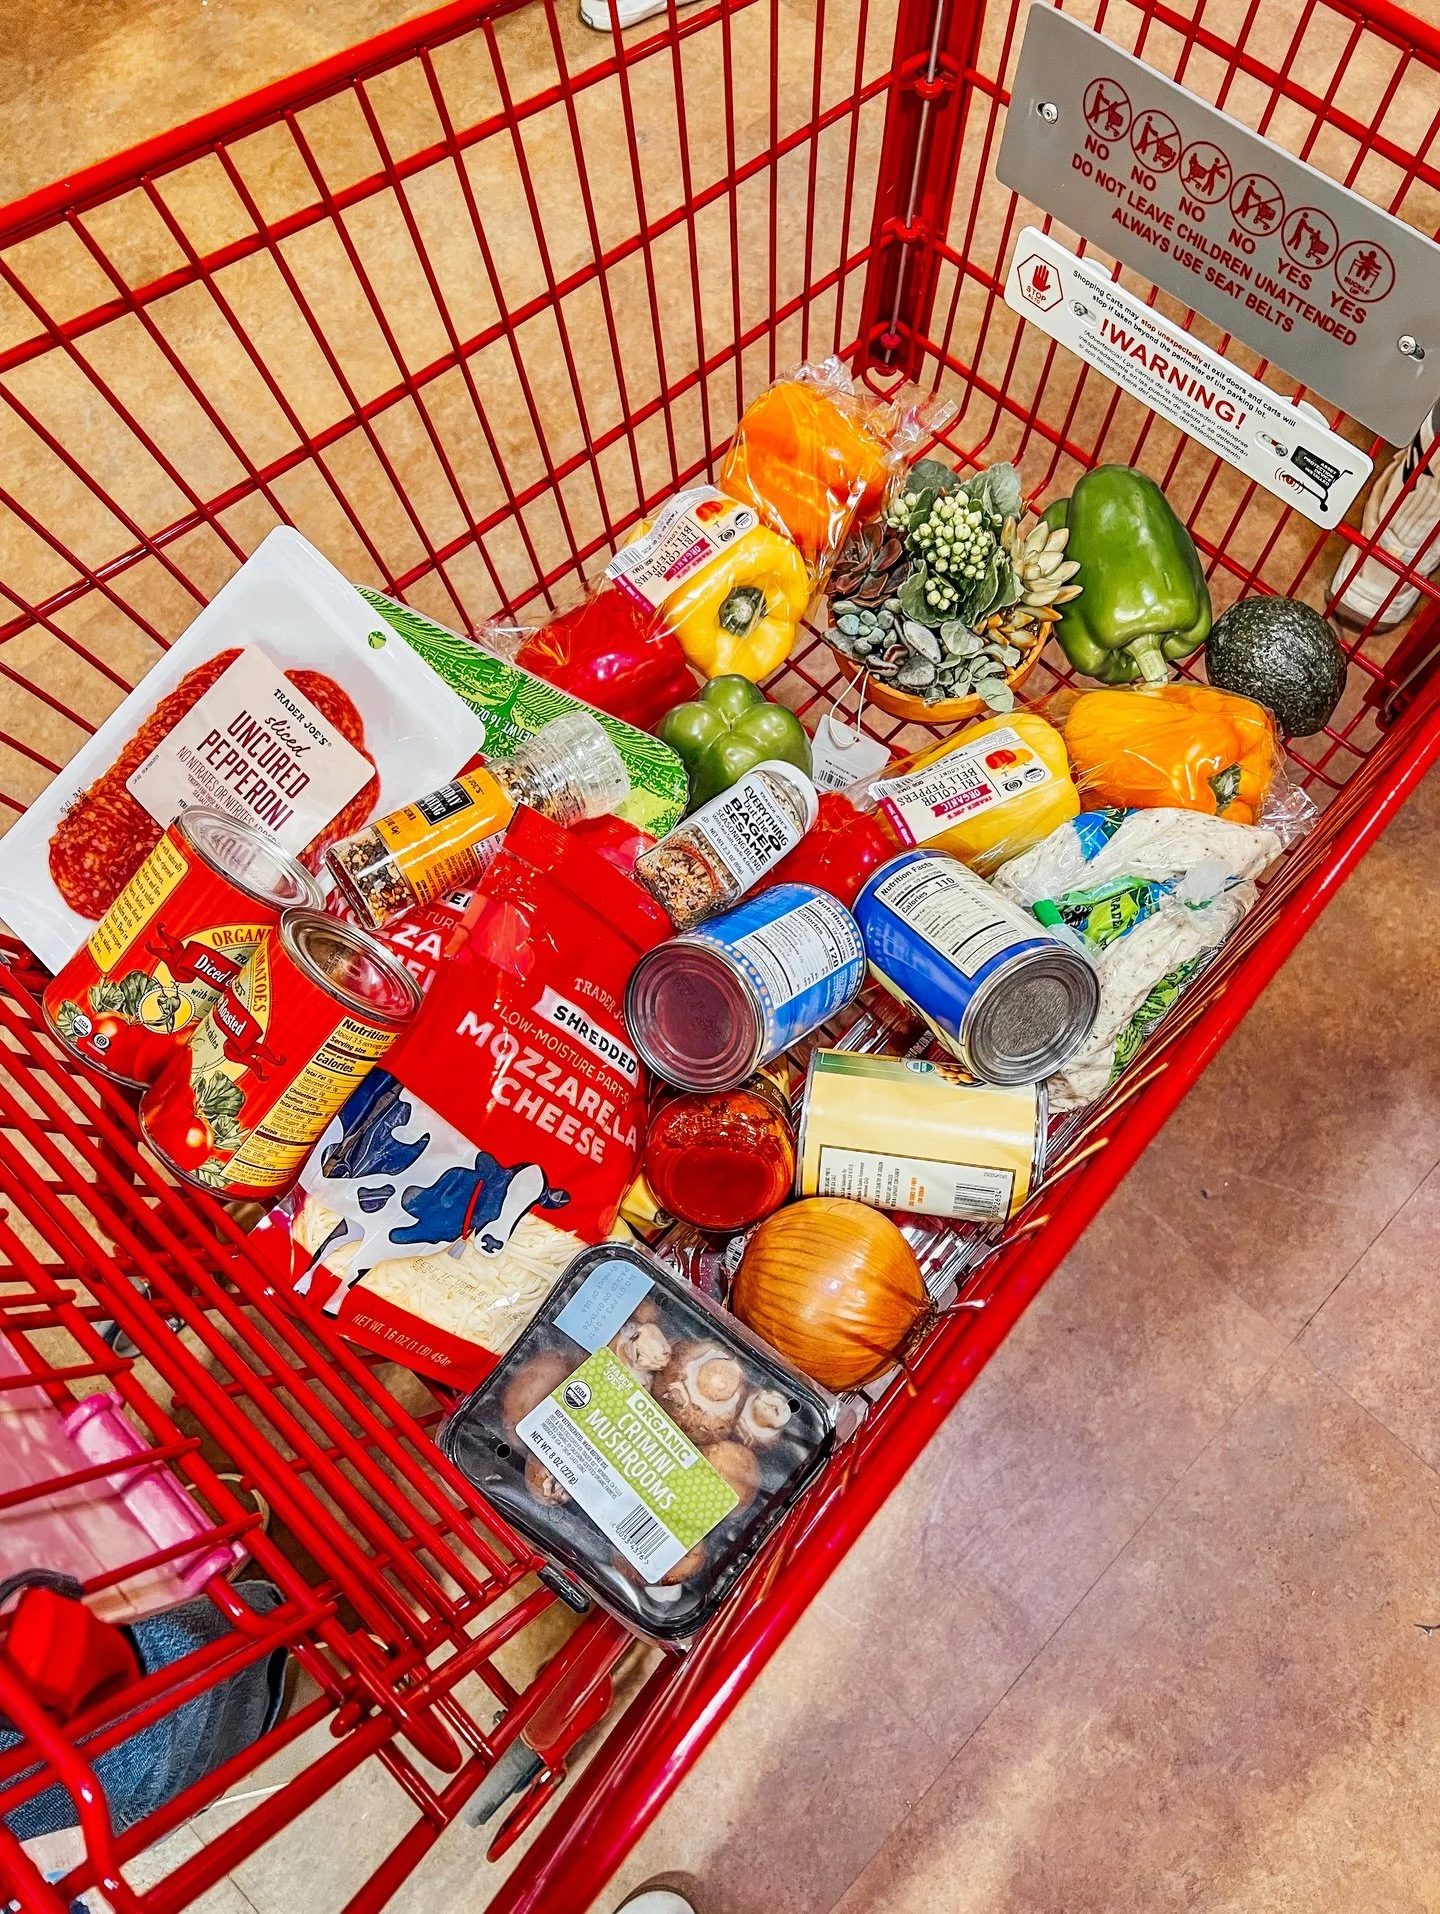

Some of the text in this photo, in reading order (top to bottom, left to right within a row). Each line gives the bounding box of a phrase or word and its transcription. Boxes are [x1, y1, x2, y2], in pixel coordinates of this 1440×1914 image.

[1083, 134, 1367, 325] NO NO NO NO YES YES
[1071, 153, 1356, 347] DO NOT LEAVE CHILDREN UNATTENDED
[1112, 206, 1294, 333] ALWAYS USE SEAT BELTS
[1343, 275, 1370, 296] BUCKLE
[1026, 284, 1045, 304] STOP
[1348, 286, 1358, 296] UP
[1072, 270, 1296, 428] Shopping Carts may stop unexpectedly at exit doors and carts will
[1091, 294, 1108, 309] stop
[1114, 309, 1132, 326] taken
[1133, 323, 1158, 345] beyond
[1158, 340, 1171, 353] the
[1171, 349, 1204, 376] perimeter
[1226, 388, 1253, 410] parking
[1102, 320, 1244, 429] !WARNING!
[1303, 456, 1333, 478] PROTECTION
[654, 532, 699, 577] TRI-COLOR
[670, 526, 692, 546] BELL
[634, 551, 670, 585] PEPPERS
[670, 546, 700, 573] ORGANIC
[272, 688, 305, 722] TRADER
[475, 705, 518, 737] WT. 16 OZ
[263, 710, 311, 759] sliced
[175, 745, 192, 763] NO
[184, 756, 220, 791] NITRATES
[212, 784, 229, 802] OR
[224, 711, 311, 799] UNCURED
[195, 730, 294, 829] PEPPERONI
[896, 766, 975, 806] BELL PEPPERS
[922, 773, 981, 807] TRI-COLOR
[741, 786, 791, 844] EVERYTHING
[741, 799, 771, 834] but the
[940, 787, 980, 811] ORGANIC
[716, 809, 762, 870] SEASONING BLEND
[718, 804, 771, 863] SESAME
[727, 798, 778, 857] BAGEL
[881, 861, 934, 894] Nutrition Facts
[902, 877, 955, 913] Calories 110
[798, 910, 840, 968] Calories 120
[816, 899, 856, 957] Nutrition Facts
[195, 955, 230, 982] Diced
[253, 945, 267, 1012] OMATOES
[191, 988, 207, 1000] with
[573, 976, 613, 1012] TRADER
[219, 999, 246, 1035] Roasted
[340, 1019, 389, 1042] Nutrition
[328, 1035, 367, 1055] Serving size
[499, 1006, 594, 1077] LOW-MOISTURE
[553, 1005, 637, 1074] SHREDDED
[314, 1051, 355, 1074] Calories
[490, 1072, 607, 1165] CHEESE
[416, 1258, 438, 1274] BEST
[579, 1298, 592, 1314] USA
[352, 1312, 372, 1329] NET
[369, 1319, 384, 1335] WT.
[383, 1325, 398, 1342] 16
[394, 1332, 410, 1349] OZ
[572, 1383, 588, 1400] USDA
[602, 1368, 622, 1390] JOE'S
[605, 1360, 633, 1390] TRADER
[616, 1412, 676, 1477] CRIMINI
[633, 1398, 690, 1461] ORGANIC
[528, 1430, 543, 1445] NET
[538, 1440, 552, 1455] WT.
[552, 1455, 564, 1468] OZ
[558, 1464, 578, 1486] (227g)
[582, 1409, 676, 1511] MUSHROOMS
